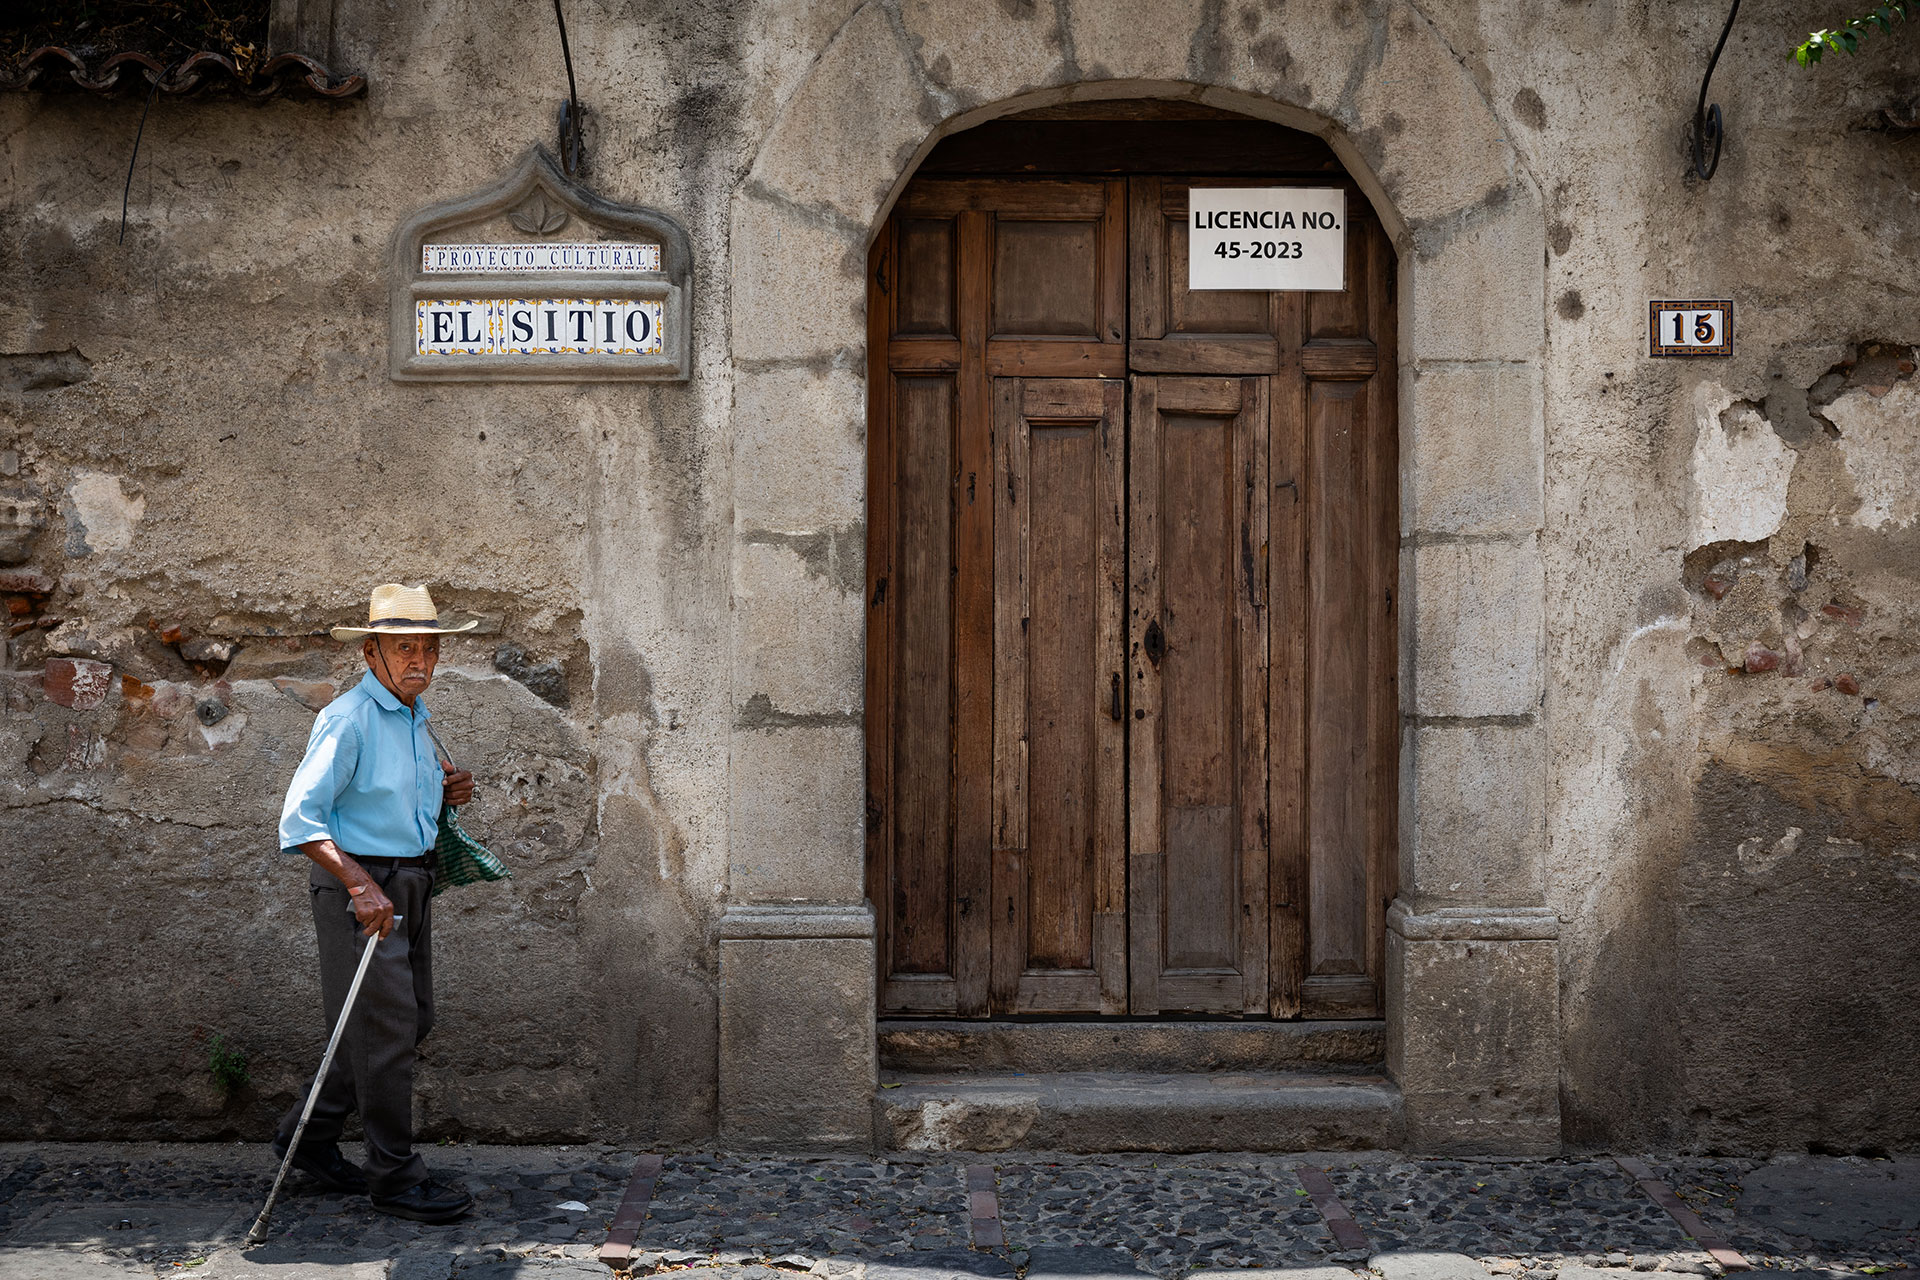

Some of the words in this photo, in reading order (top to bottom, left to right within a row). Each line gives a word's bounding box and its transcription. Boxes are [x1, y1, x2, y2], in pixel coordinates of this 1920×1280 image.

[1195, 211, 1296, 229] LICENCIA
[1302, 211, 1340, 230] NO.
[438, 251, 535, 266] PROYECTO
[550, 250, 646, 266] CULTURAL
[1214, 241, 1303, 259] 45-2023
[430, 310, 481, 343] EL
[511, 309, 651, 343] SITIO
[1672, 312, 1715, 344] 15
